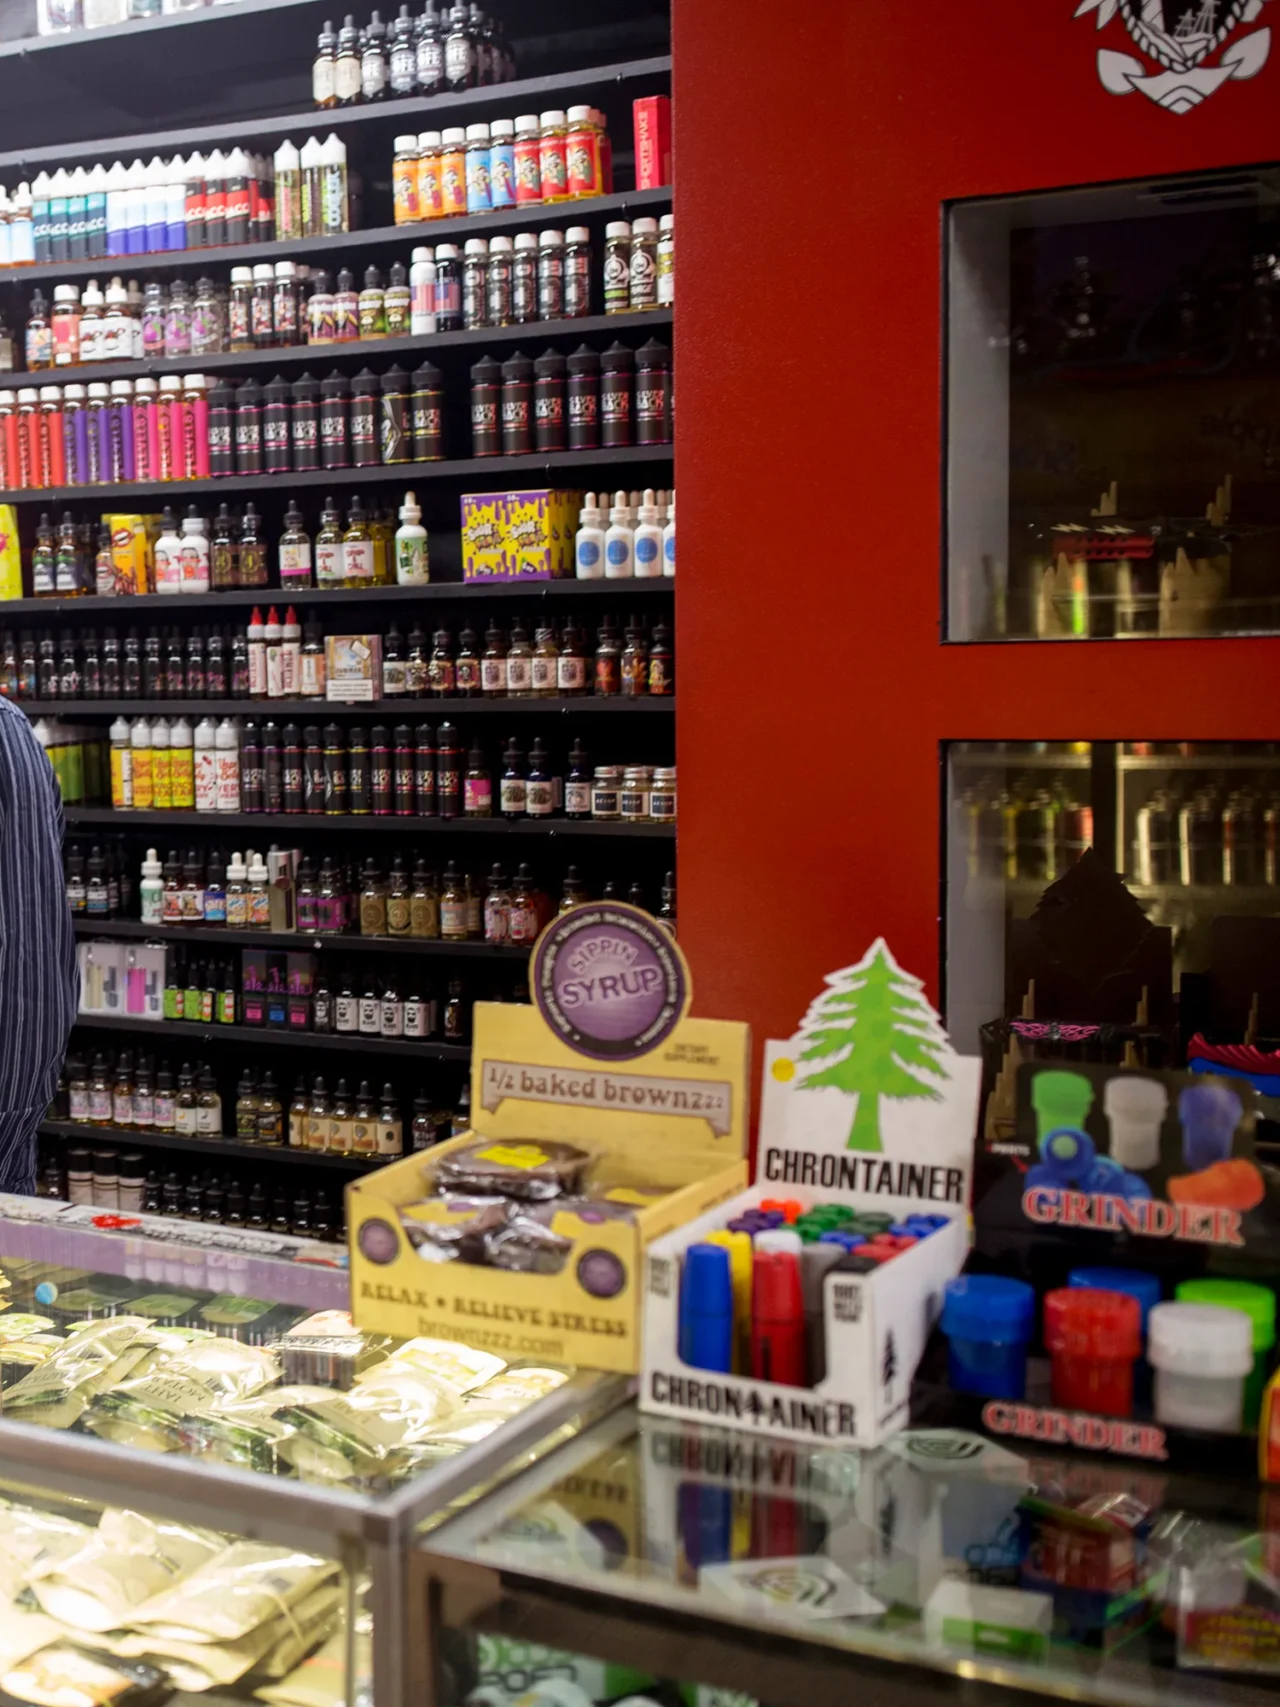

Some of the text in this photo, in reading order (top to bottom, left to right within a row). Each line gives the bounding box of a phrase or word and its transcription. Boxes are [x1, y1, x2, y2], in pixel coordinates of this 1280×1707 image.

[563, 967, 658, 1005] SYRUP
[489, 1068, 724, 1110] 1/2 baked brownzzz
[765, 1148, 964, 1203] CHRONTAINER
[1024, 1185, 1245, 1246] GRINDER
[360, 1280, 628, 1338] RELAX RELIEVE STRESS
[982, 1401, 1169, 1462] GRINDER
